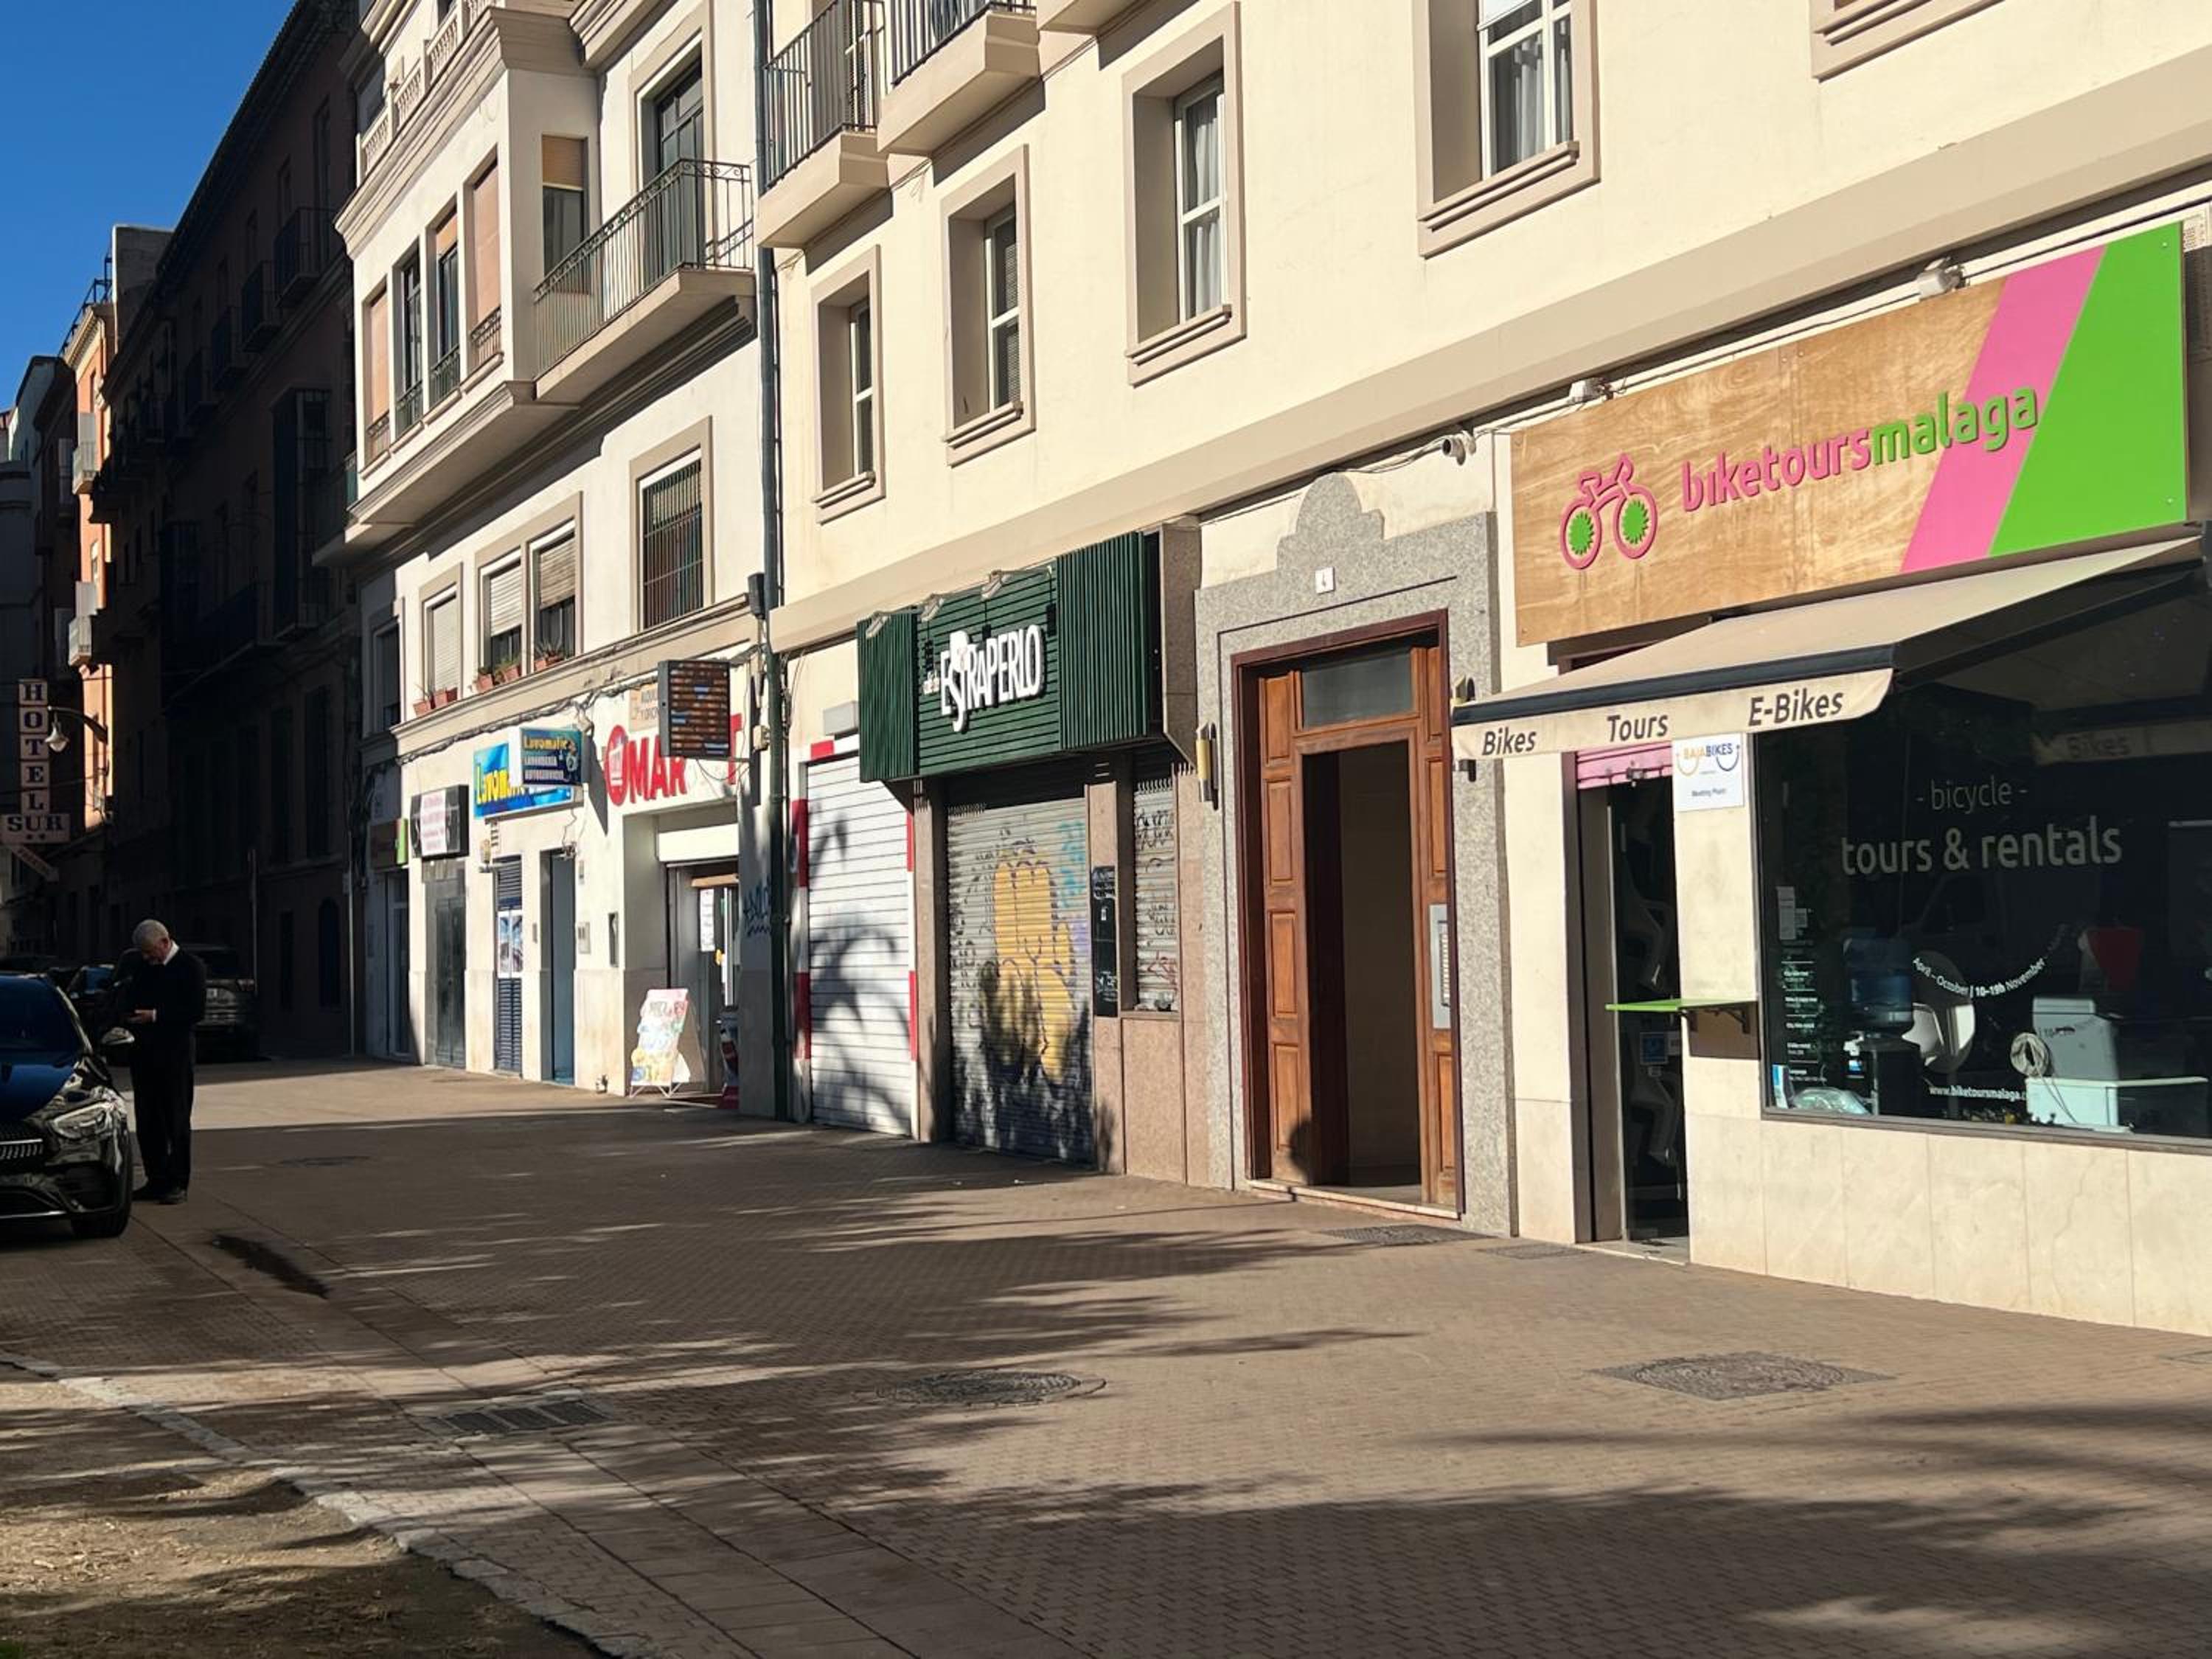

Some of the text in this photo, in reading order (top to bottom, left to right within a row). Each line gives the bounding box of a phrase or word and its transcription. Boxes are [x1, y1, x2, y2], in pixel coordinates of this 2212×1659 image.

[1681, 386, 2039, 512] biketoursmalaga
[1748, 688, 1844, 727] E-Bikes
[24, 683, 44, 811] HOTEL
[1482, 728, 1537, 756] Bikes
[1607, 713, 1668, 742] Tours
[1930, 775, 2012, 815] bicycle
[7, 815, 63, 832] SUR
[1842, 815, 2122, 875] tours & rentals
